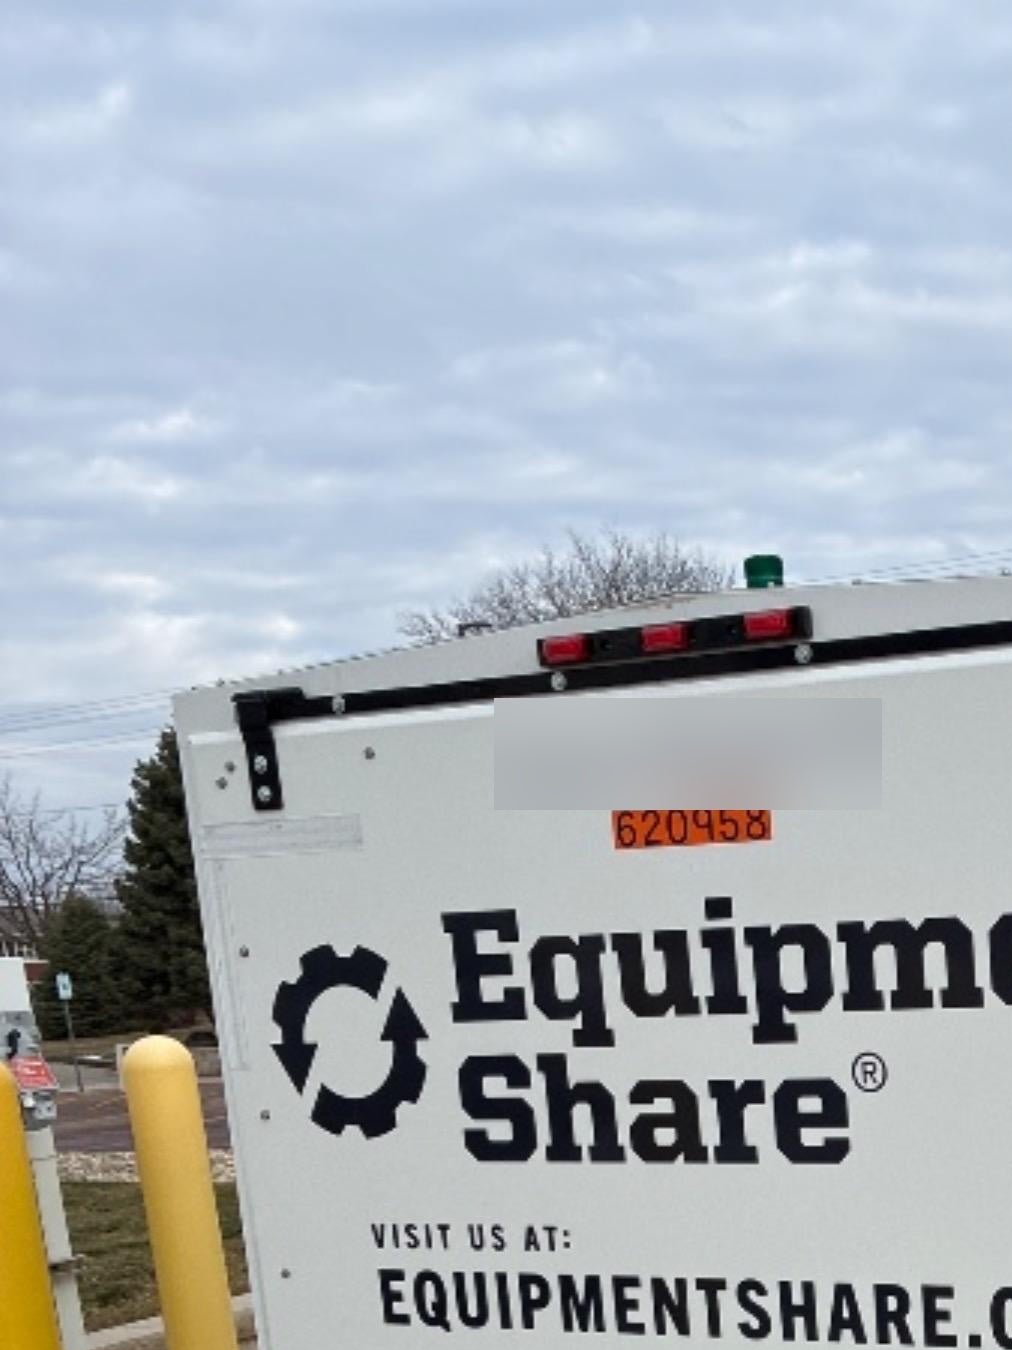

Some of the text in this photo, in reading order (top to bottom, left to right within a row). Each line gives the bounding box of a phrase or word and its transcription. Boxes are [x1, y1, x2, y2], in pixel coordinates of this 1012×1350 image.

[615, 810, 766, 848] 620958
[370, 1222, 572, 1252] VISIT US AT:
